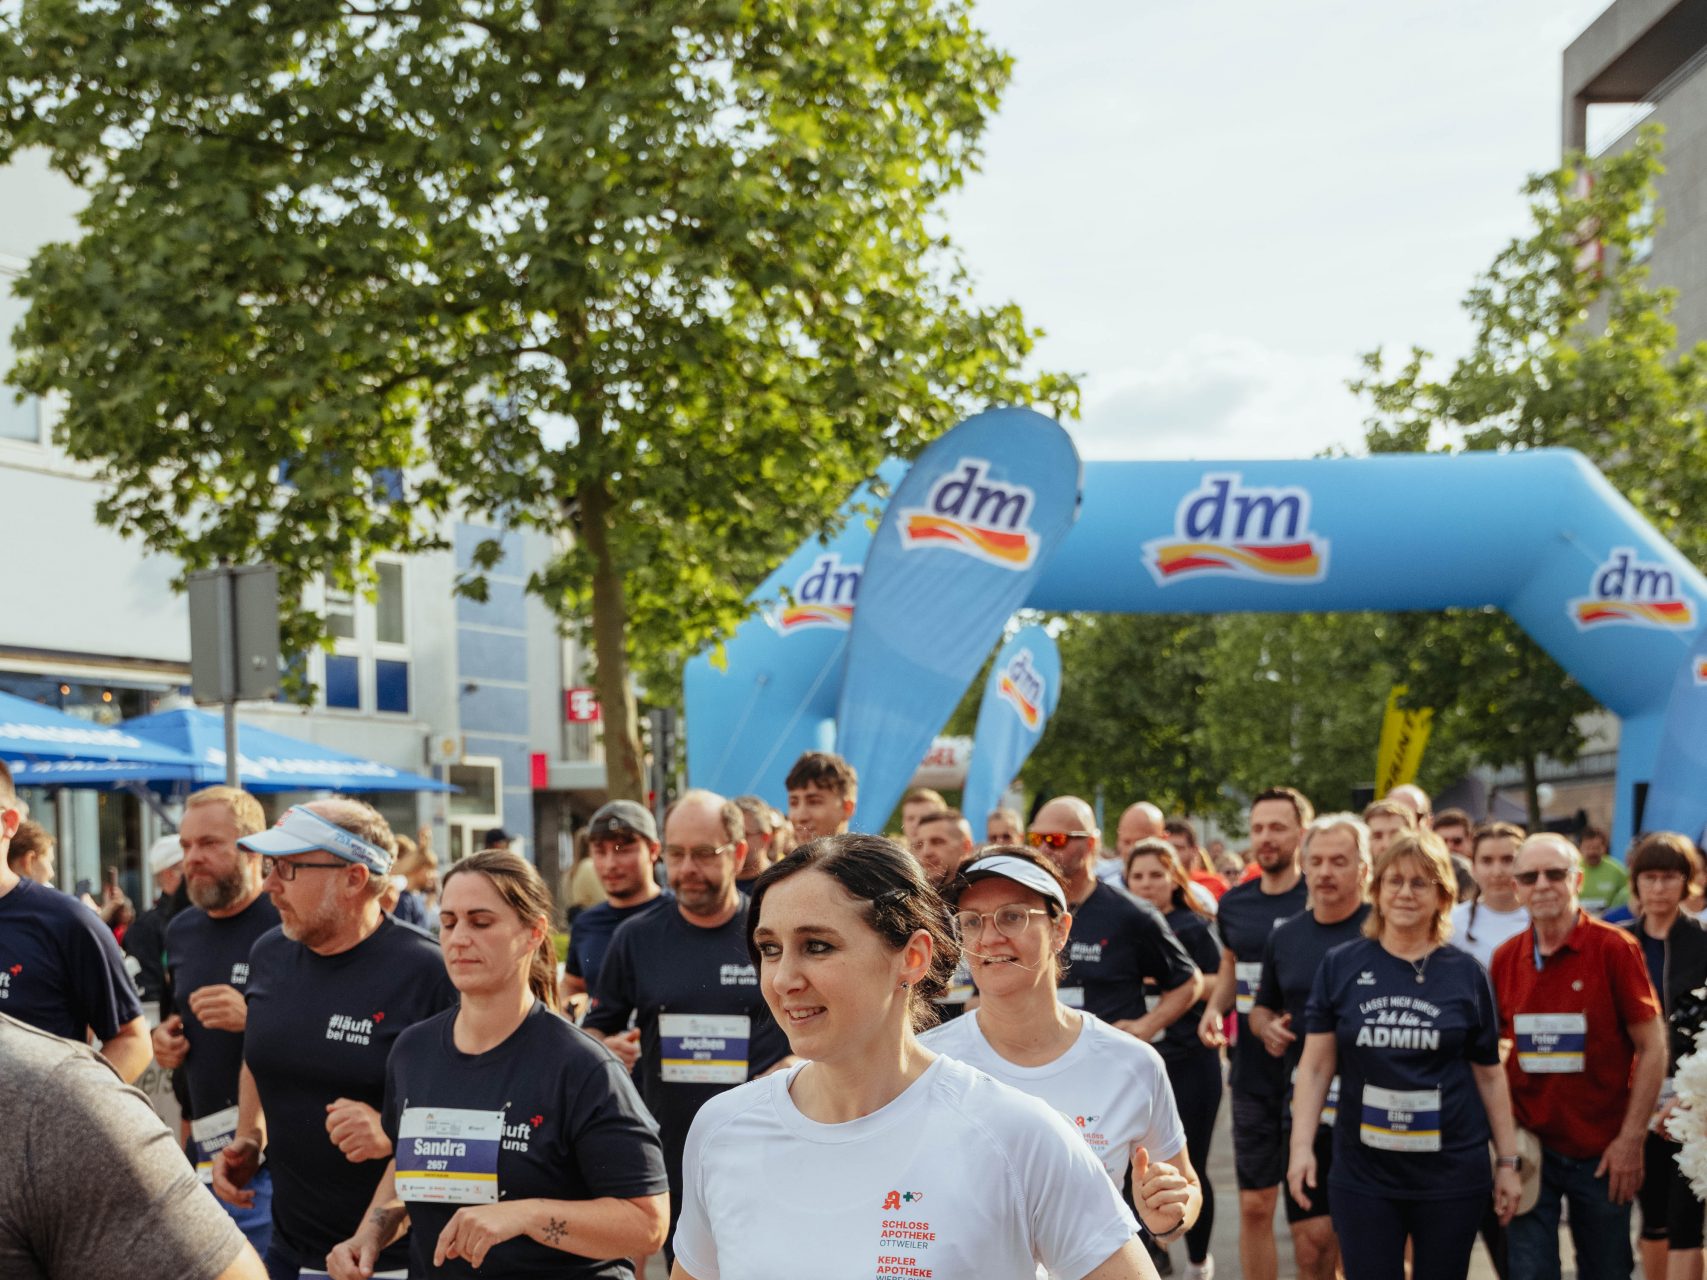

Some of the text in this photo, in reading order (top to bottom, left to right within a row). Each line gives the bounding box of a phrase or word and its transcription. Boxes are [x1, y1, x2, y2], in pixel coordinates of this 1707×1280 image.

[933, 466, 1027, 529] dm
[1186, 480, 1300, 540] dm
[1600, 554, 1673, 600] dm
[1389, 996, 1413, 1008] MICH
[328, 1013, 373, 1035] #läuft
[326, 1027, 370, 1046] bei uns
[1355, 1026, 1441, 1050] ADMIN
[414, 1138, 467, 1157] Sandra
[502, 1140, 529, 1153] uns
[881, 1220, 929, 1231] SCHLOSS
[880, 1230, 936, 1241] APOTHEKE
[879, 1239, 929, 1250] OTTWEILER
[877, 1255, 916, 1266] KEPLER
[876, 1266, 933, 1278] APOTHEKE
